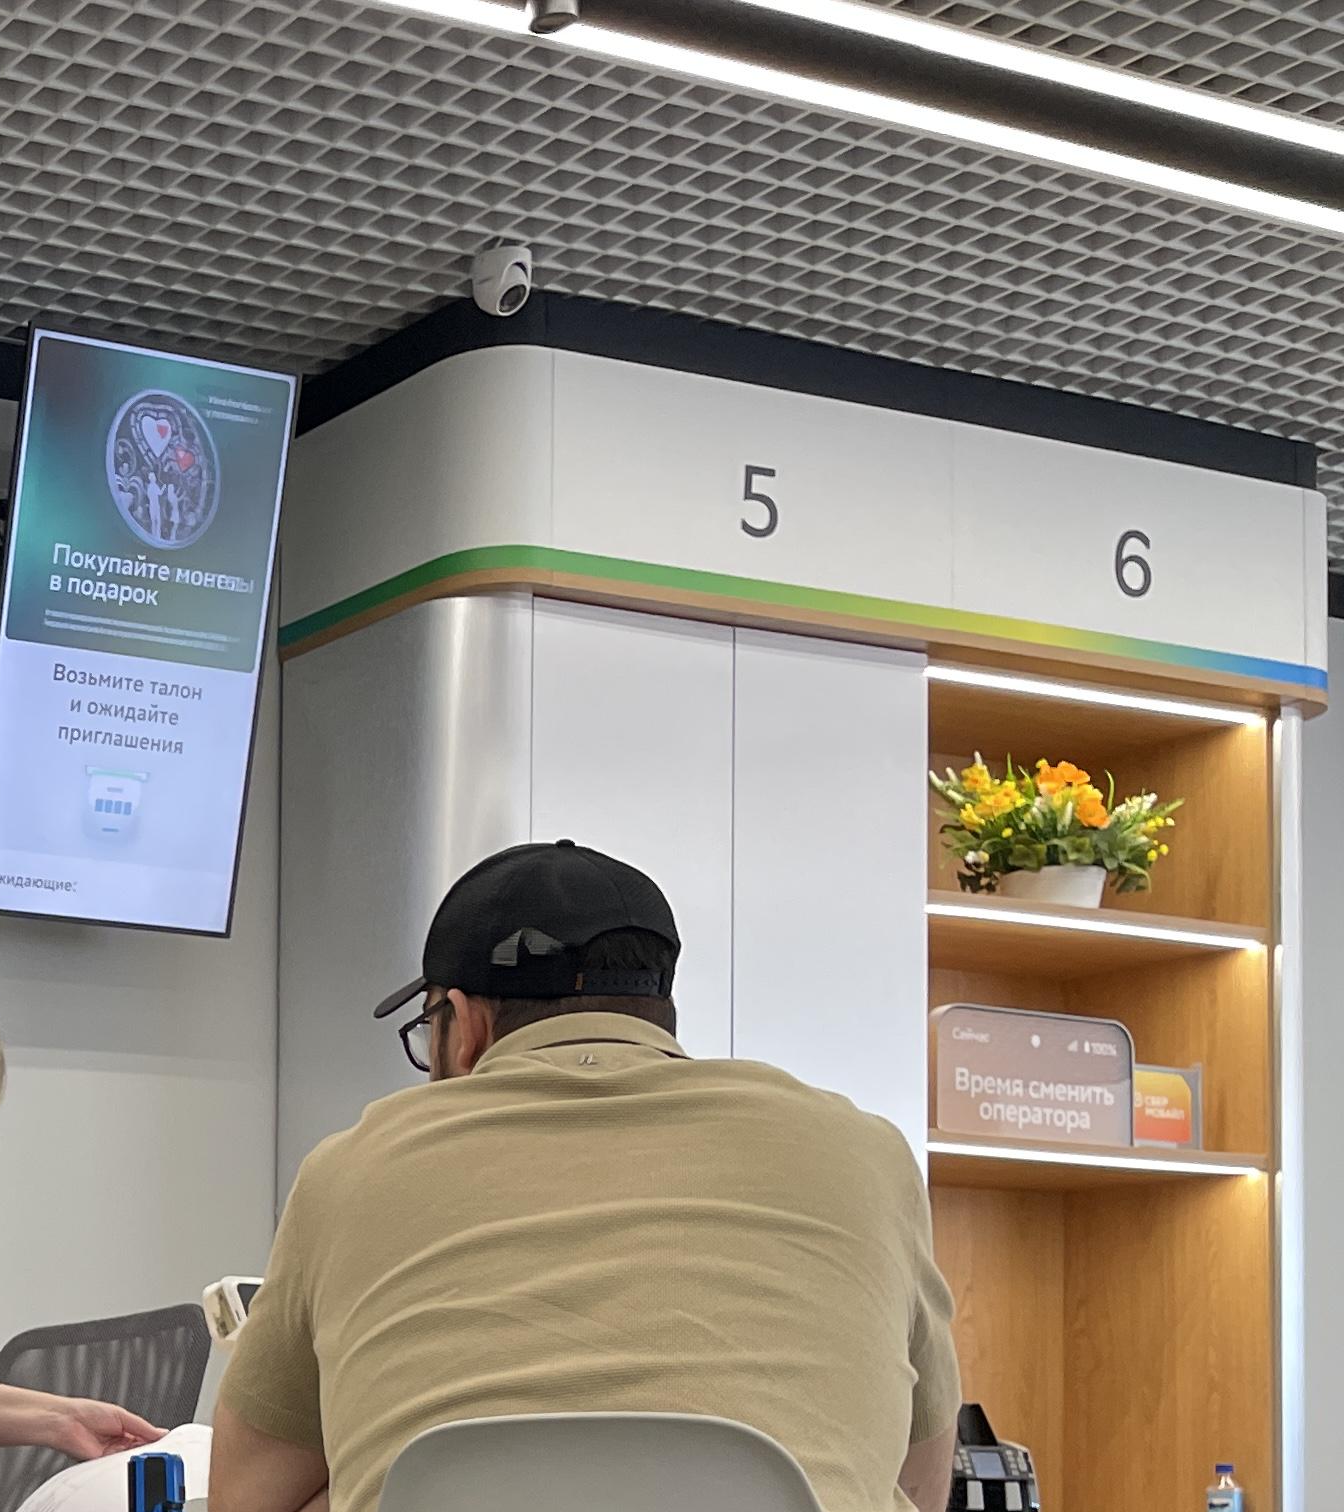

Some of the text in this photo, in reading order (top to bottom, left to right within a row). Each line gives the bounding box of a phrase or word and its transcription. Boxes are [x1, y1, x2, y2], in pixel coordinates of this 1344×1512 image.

[740, 464, 779, 538] 5
[52, 542, 170, 582] Покупайте
[1115, 529, 1152, 598] 6
[49, 574, 159, 607] в подарок
[52, 663, 203, 700] Возьмите талон
[69, 698, 179, 726] и ожидайте
[58, 725, 184, 755] приглашения
[955, 1067, 1115, 1107] Время сменить
[979, 1101, 1092, 1133] оператора
